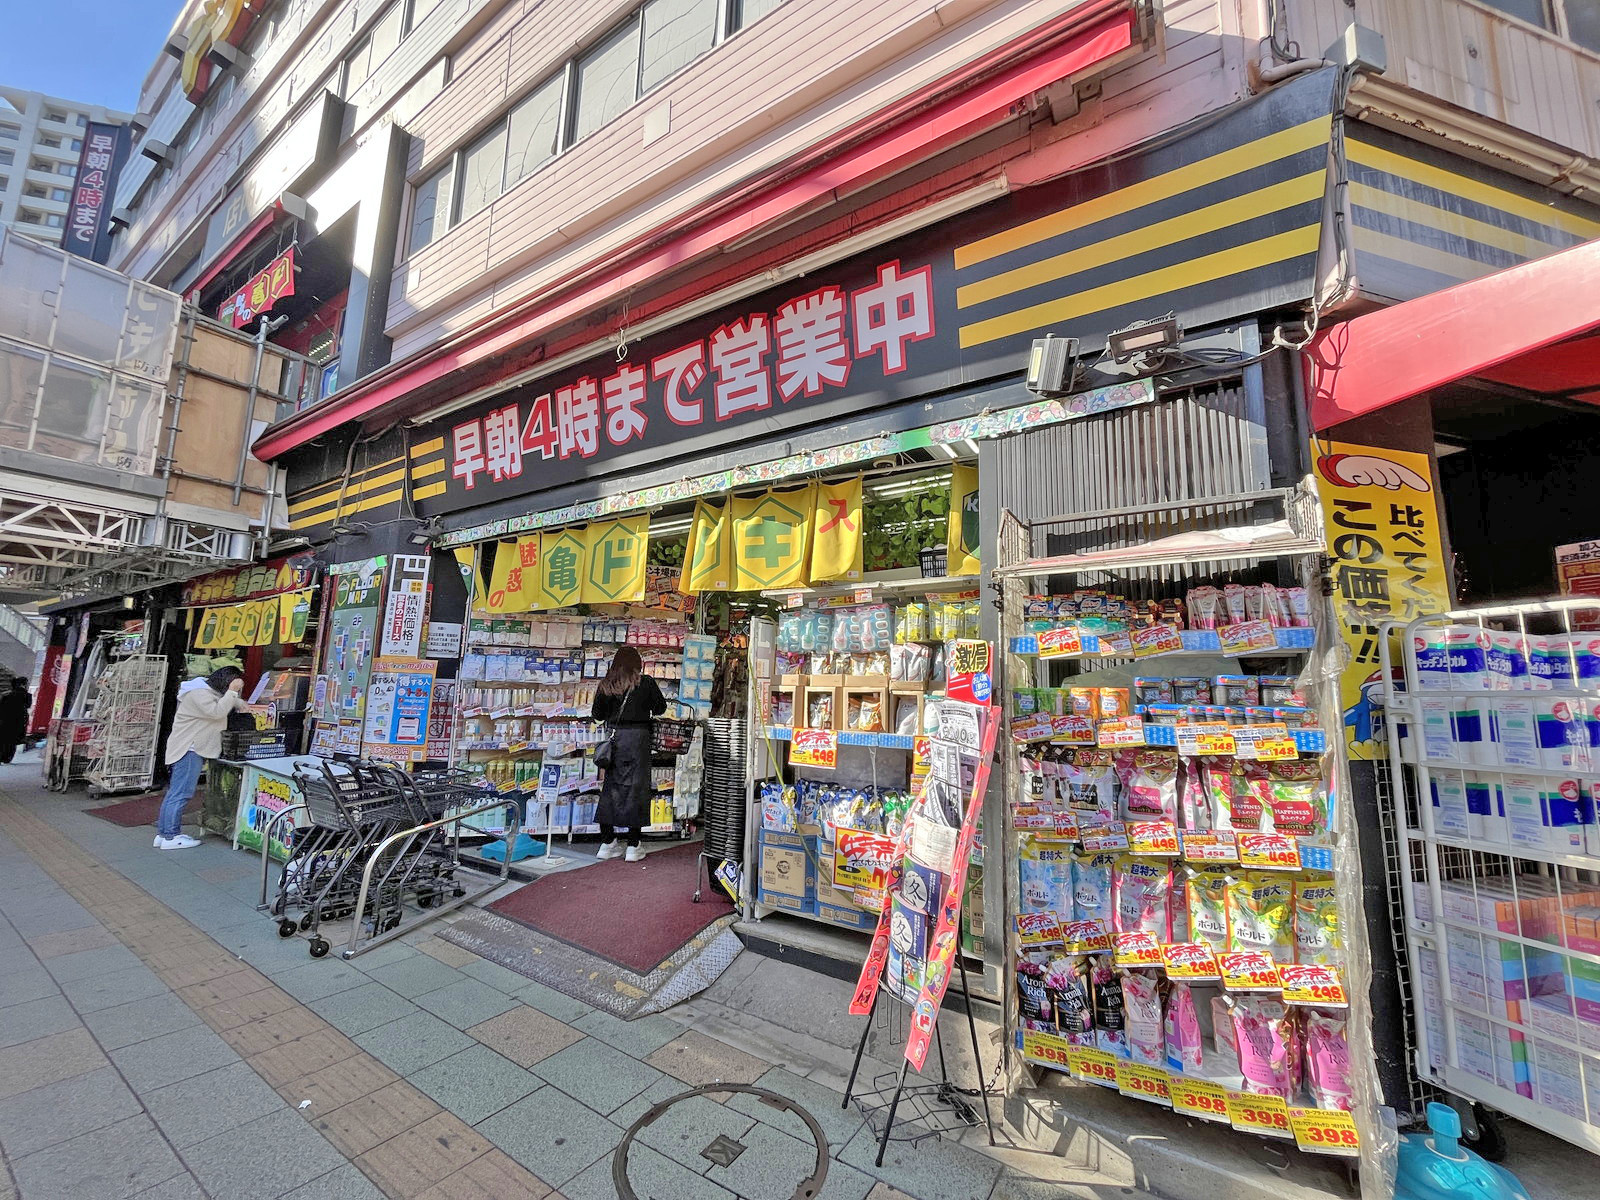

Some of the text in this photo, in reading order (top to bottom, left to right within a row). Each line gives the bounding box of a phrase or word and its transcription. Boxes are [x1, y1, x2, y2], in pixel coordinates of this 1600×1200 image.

[73, 134, 113, 242] 早朝4時まで
[453, 259, 937, 490] 早朝4時まで営業中
[1059, 640, 1079, 651] 198
[1156, 637, 1180, 650] 880
[1071, 729, 1093, 739] 198
[1212, 742, 1233, 751] 148
[1273, 746, 1295, 756] 148
[1079, 750, 1103, 762] 特大
[1142, 753, 1169, 766] 特大
[1278, 764, 1311, 776] 特大
[1274, 808, 1310, 816] HAPPINESS
[1056, 826, 1077, 837] 498
[1152, 837, 1177, 849] 498
[1039, 850, 1063, 861] 超特大
[1269, 852, 1297, 863] 498
[1130, 863, 1159, 877] 超特大
[1251, 884, 1282, 900] 超特大
[1302, 886, 1335, 900] 超特大
[1198, 919, 1225, 931] ボールド
[1040, 926, 1061, 938] 298
[1236, 927, 1266, 941] ボールド
[1136, 949, 1160, 960] 298
[1190, 960, 1216, 973] 298
[1250, 971, 1278, 984] 298
[1027, 986, 1047, 998] Rich
[1310, 985, 1342, 999] 298
[1034, 1045, 1068, 1063] 398
[1080, 1060, 1117, 1079] 398
[1129, 1077, 1169, 1096] 398
[1183, 1093, 1227, 1112] 398
[1242, 1108, 1289, 1128] 398
[1307, 1127, 1358, 1145] 398
